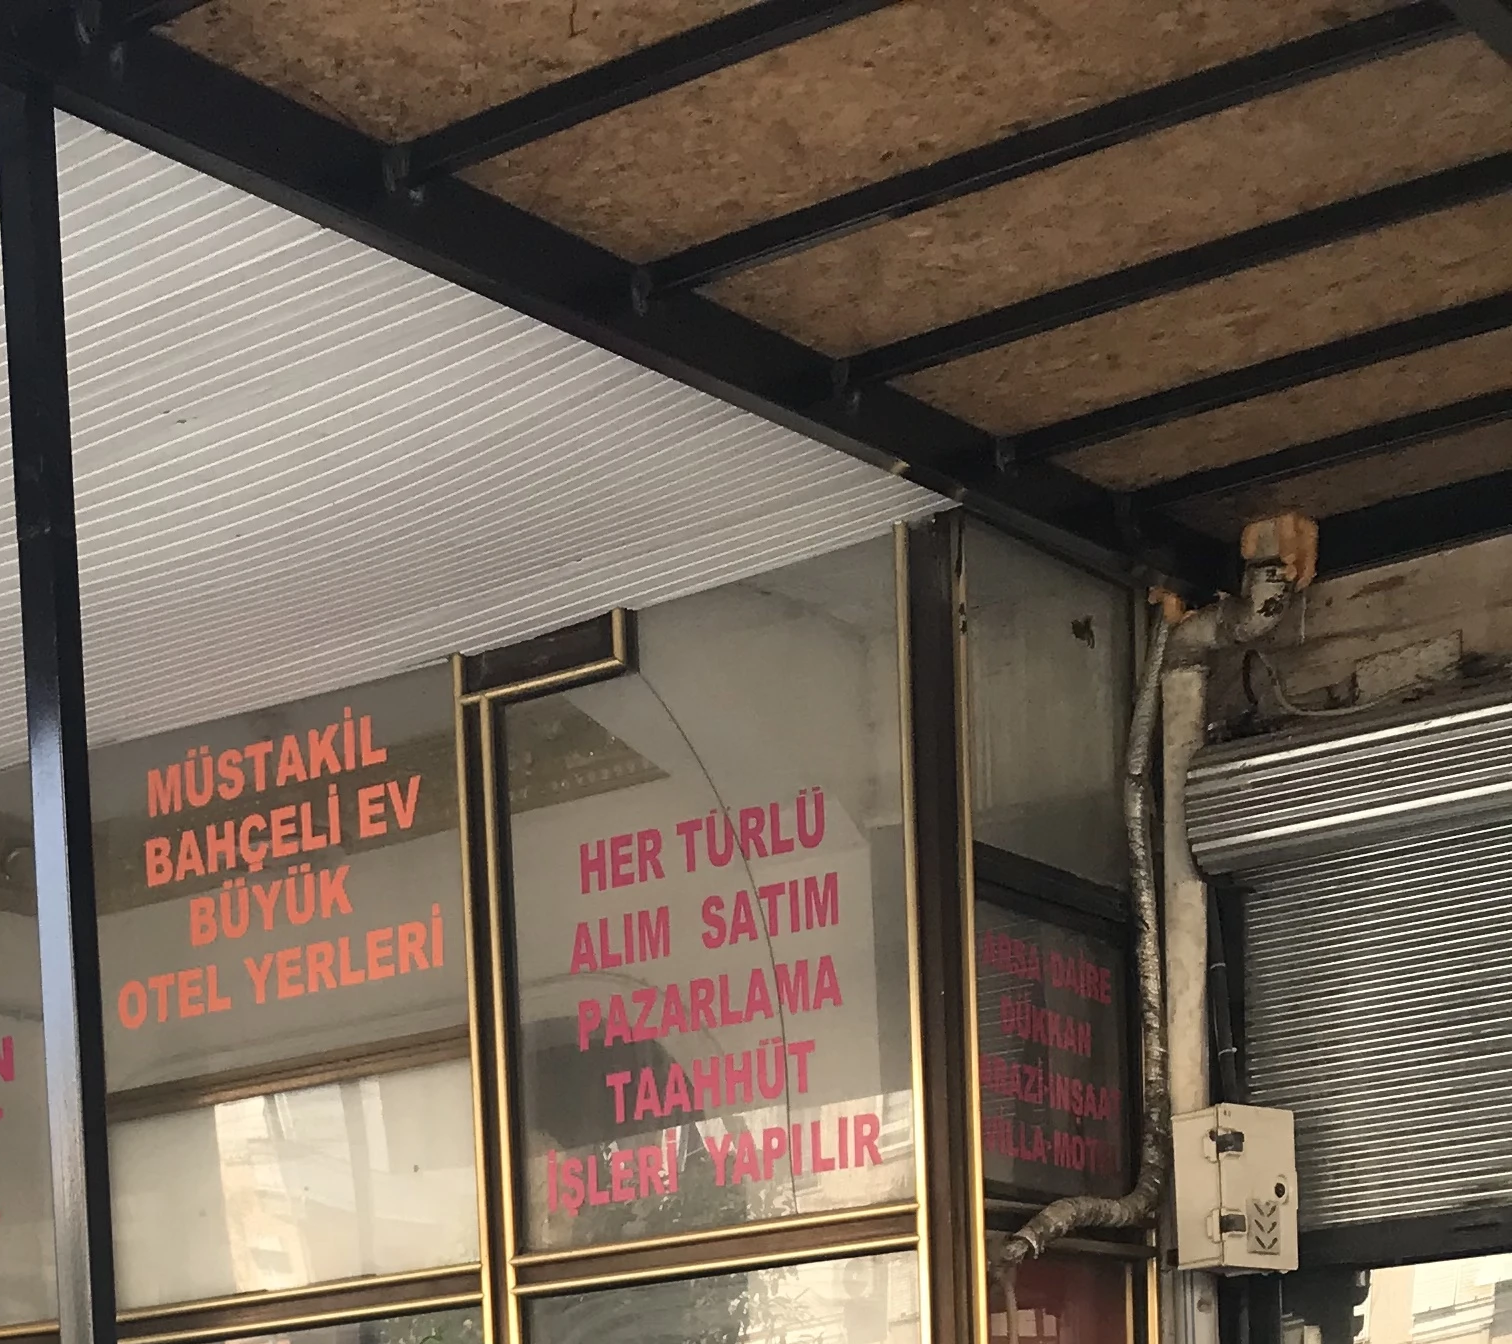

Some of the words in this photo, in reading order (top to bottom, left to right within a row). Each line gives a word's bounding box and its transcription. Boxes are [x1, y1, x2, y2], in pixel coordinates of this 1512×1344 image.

[147, 705, 388, 818] MÜSTAKİL
[145, 792, 341, 887] BAHÇELİ
[357, 775, 422, 839] EV
[580, 827, 665, 894] HER
[677, 786, 827, 873] TÜRLÜ
[189, 865, 353, 947] BÜYÜK
[569, 907, 671, 975] ALIM
[701, 872, 840, 950] SATIM
[117, 962, 232, 1031] OTEL
[244, 902, 446, 1004] YERLERİ
[578, 954, 843, 1052] PAZARLAMA
[605, 1038, 817, 1124] TAAHHÜT
[547, 1130, 680, 1218] İŞLERİ
[705, 1111, 883, 1189] YAPILIR
